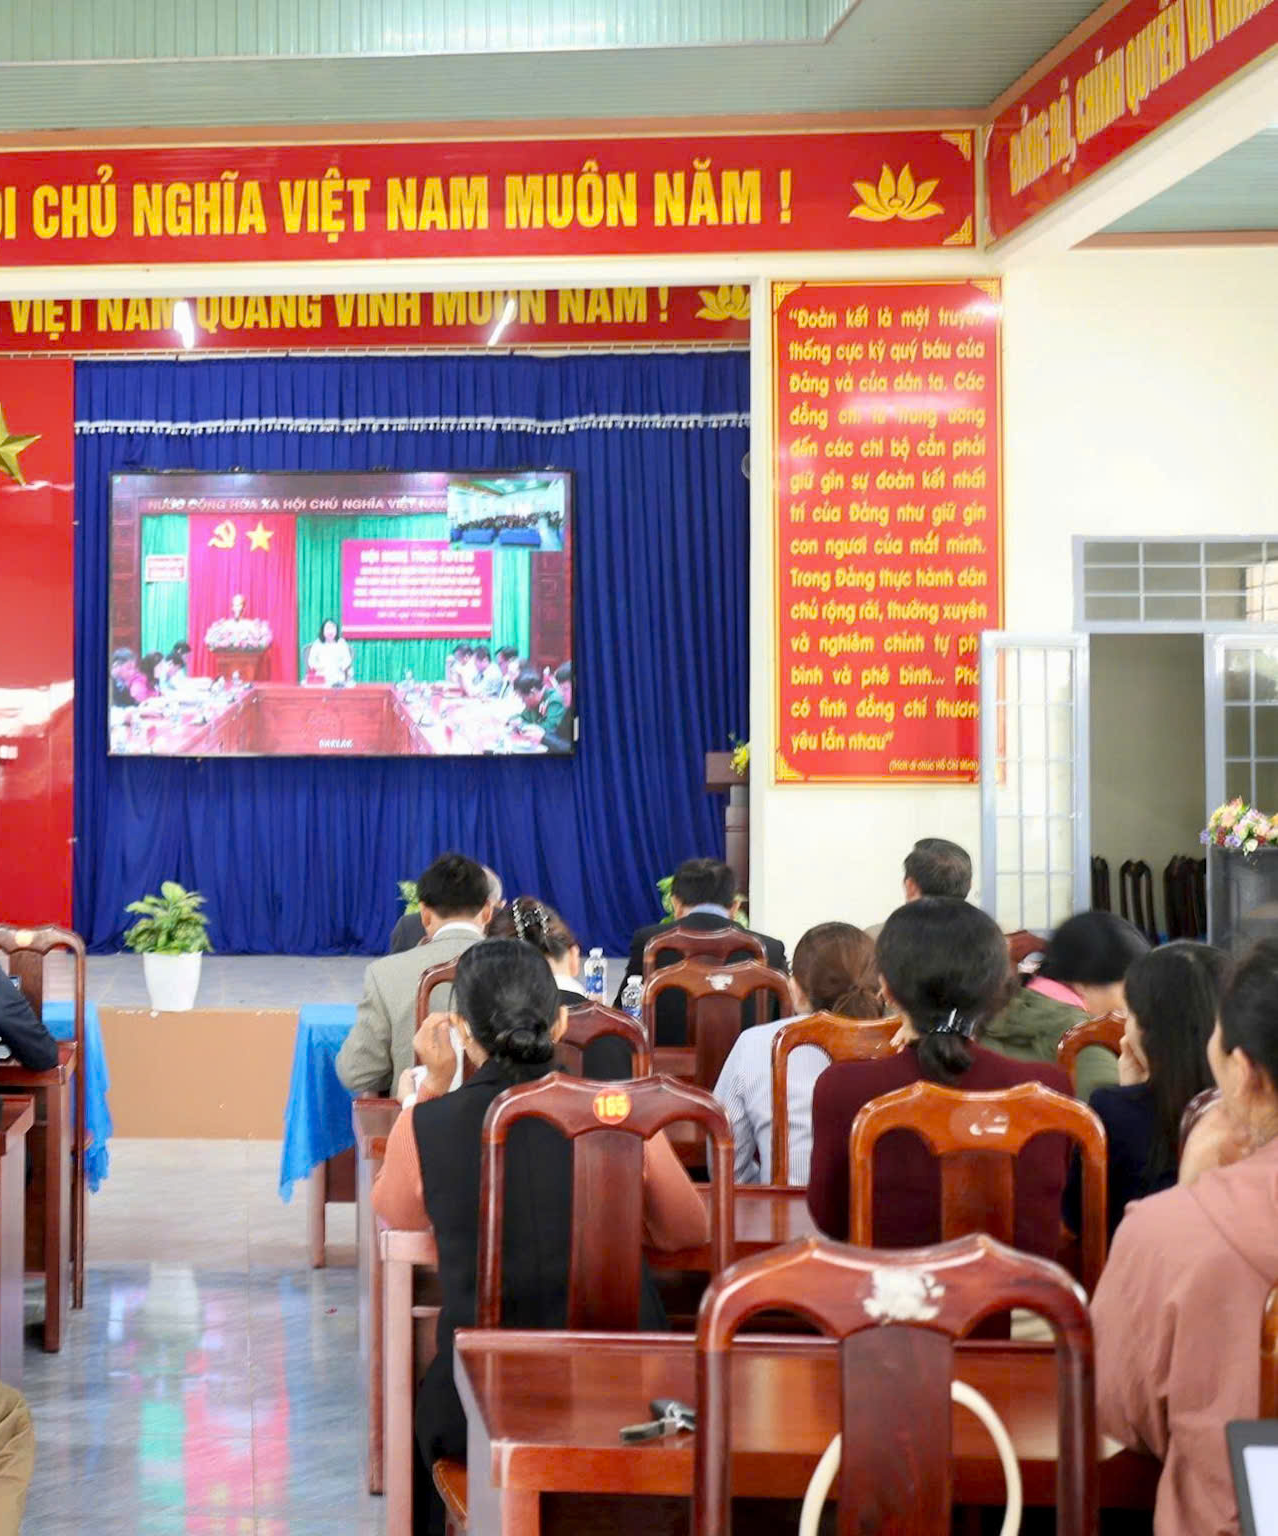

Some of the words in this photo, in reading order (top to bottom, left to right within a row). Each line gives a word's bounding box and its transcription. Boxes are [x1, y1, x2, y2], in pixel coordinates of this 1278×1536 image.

[1076, 46, 1125, 144] CHÍNH
[34, 164, 117, 239] CHỦ
[133, 170, 266, 238] NGHĨA
[279, 166, 370, 243] VIỆT
[386, 176, 489, 232] NAM
[505, 159, 638, 229] MUÔN
[654, 157, 761, 227] NĂM
[779, 169, 792, 224] !
[196, 294, 322, 334] QUANG
[329, 293, 421, 330] VINH
